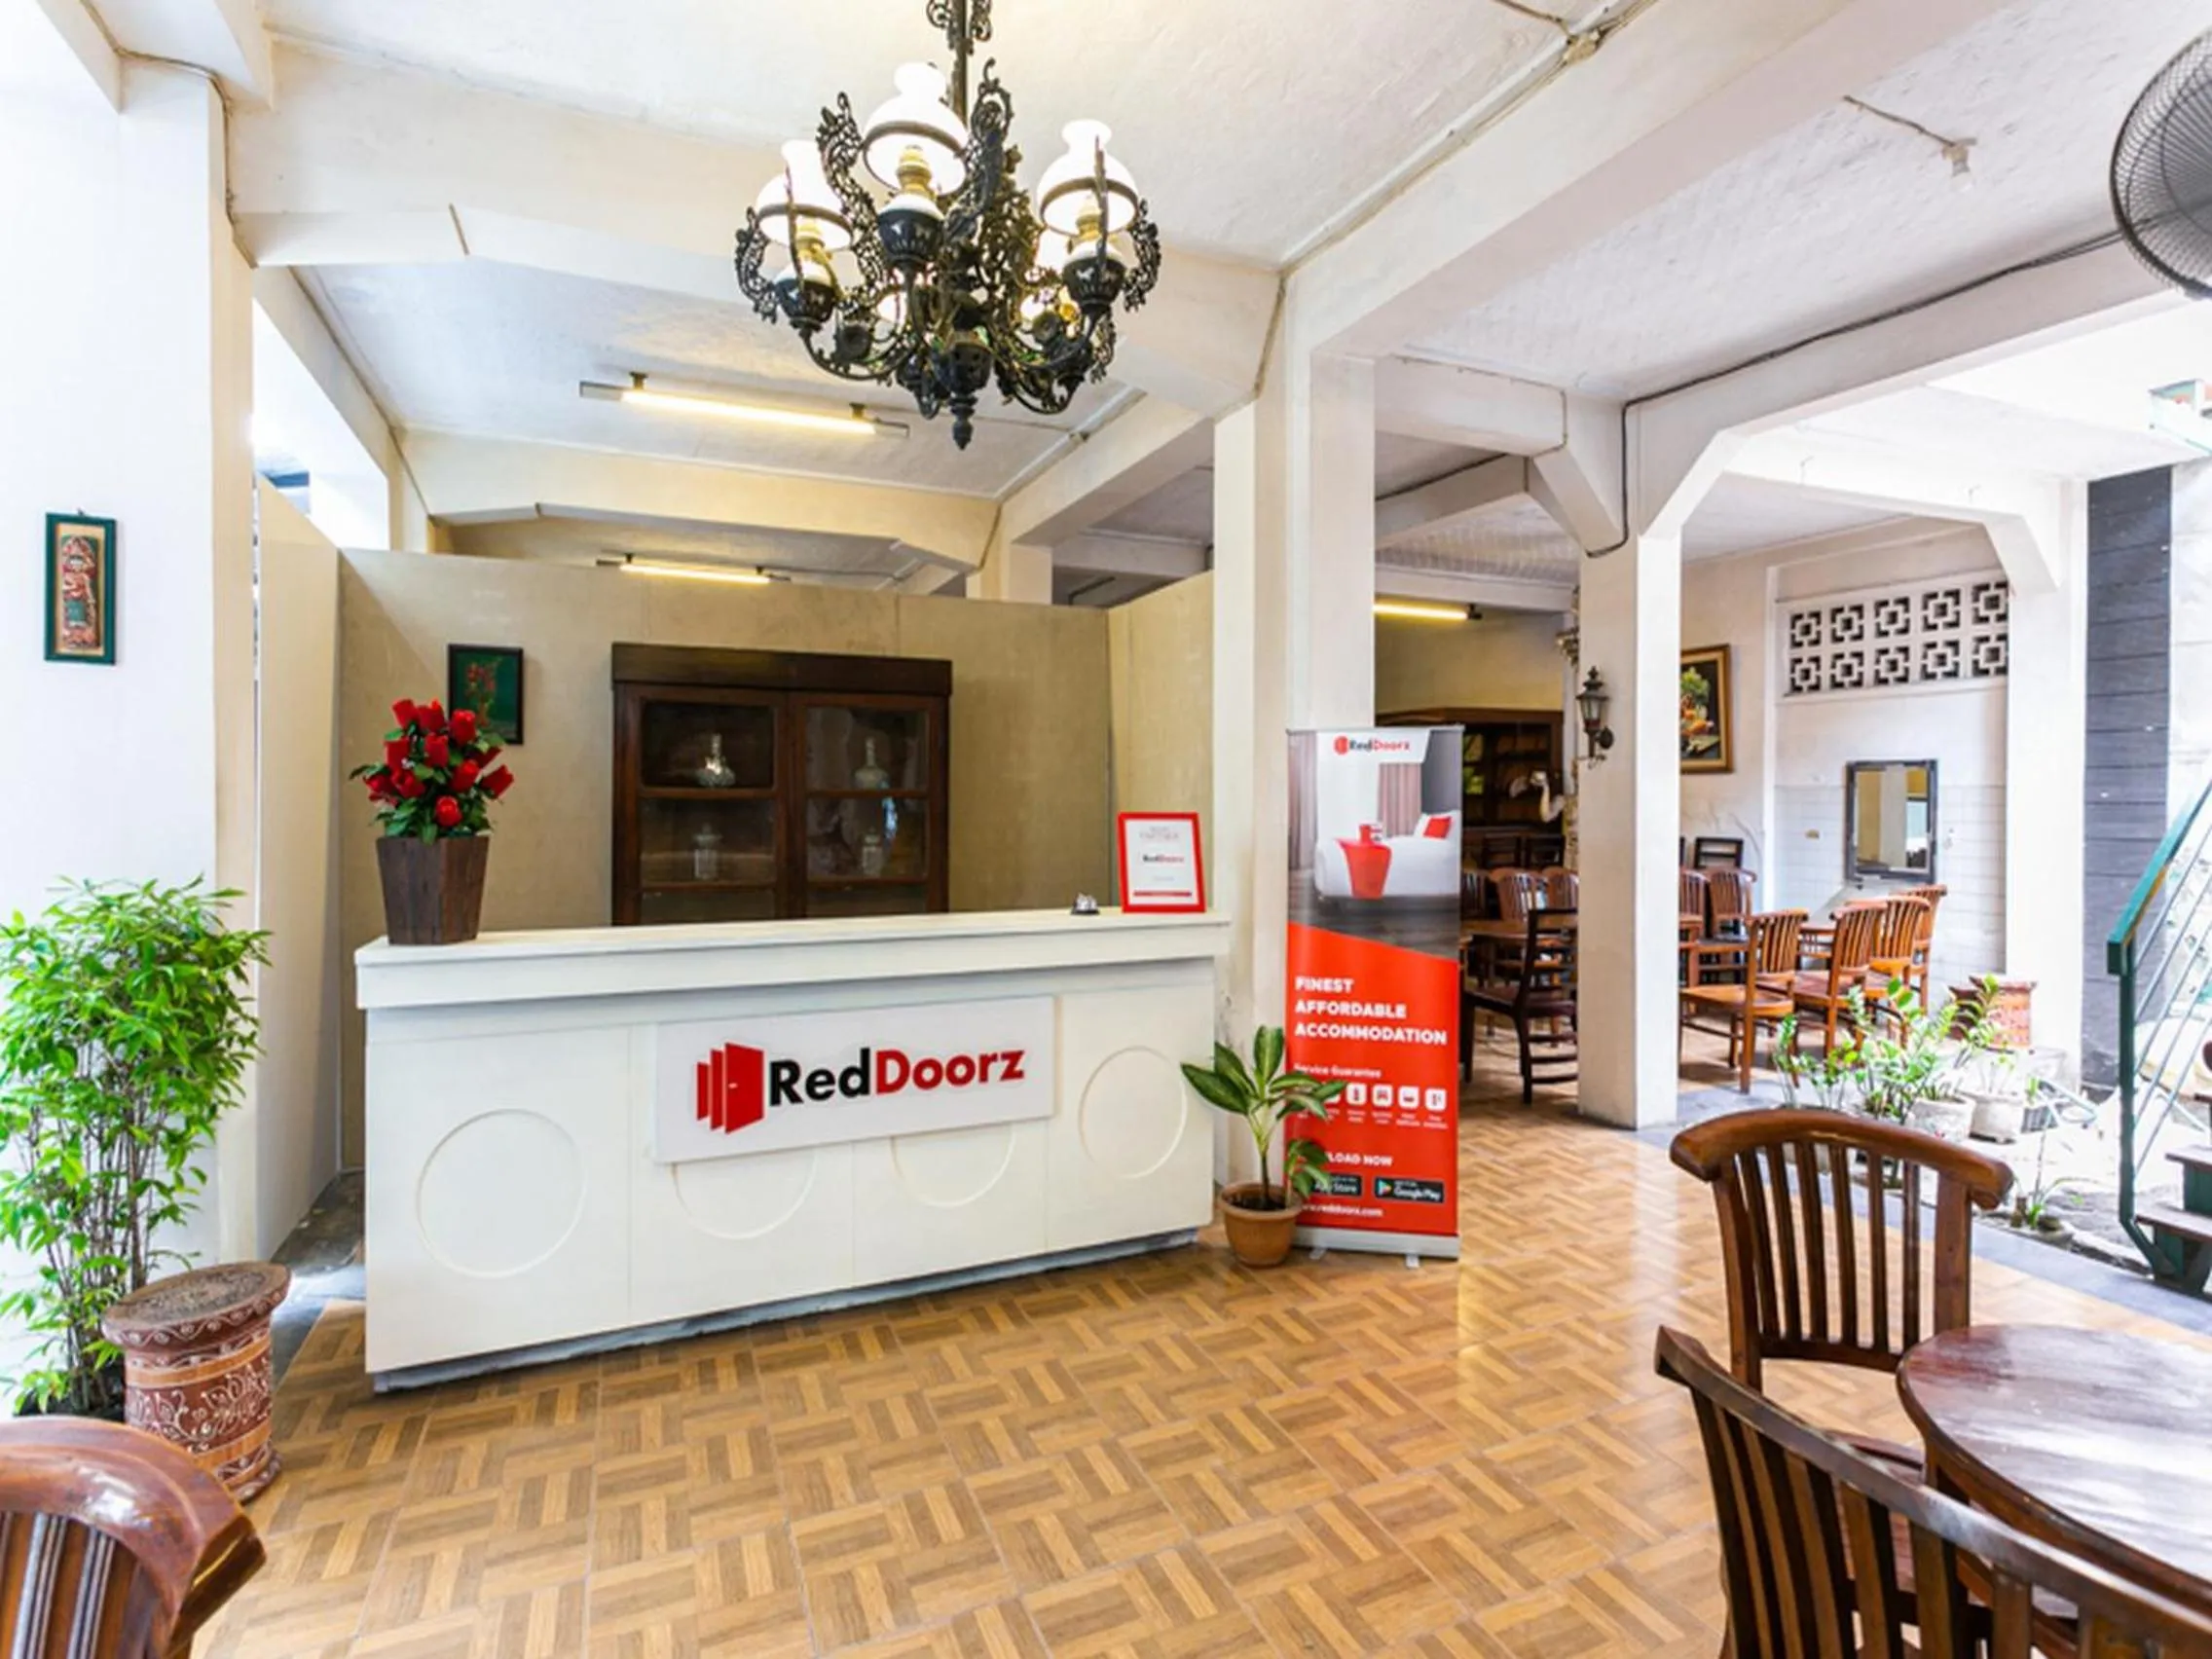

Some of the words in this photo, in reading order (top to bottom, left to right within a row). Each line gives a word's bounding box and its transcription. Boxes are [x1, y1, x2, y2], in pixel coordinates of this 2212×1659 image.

[1349, 736, 1411, 753] RedDoorz
[1295, 976, 1353, 993] FINEST
[1295, 1000, 1407, 1018] AFFORDABLE
[1295, 1022, 1448, 1045] ACCOMMODATION
[769, 1047, 1025, 1107] RedDoorz
[1331, 1064, 1382, 1079] Guarantee
[1363, 1155, 1393, 1167] NOW
